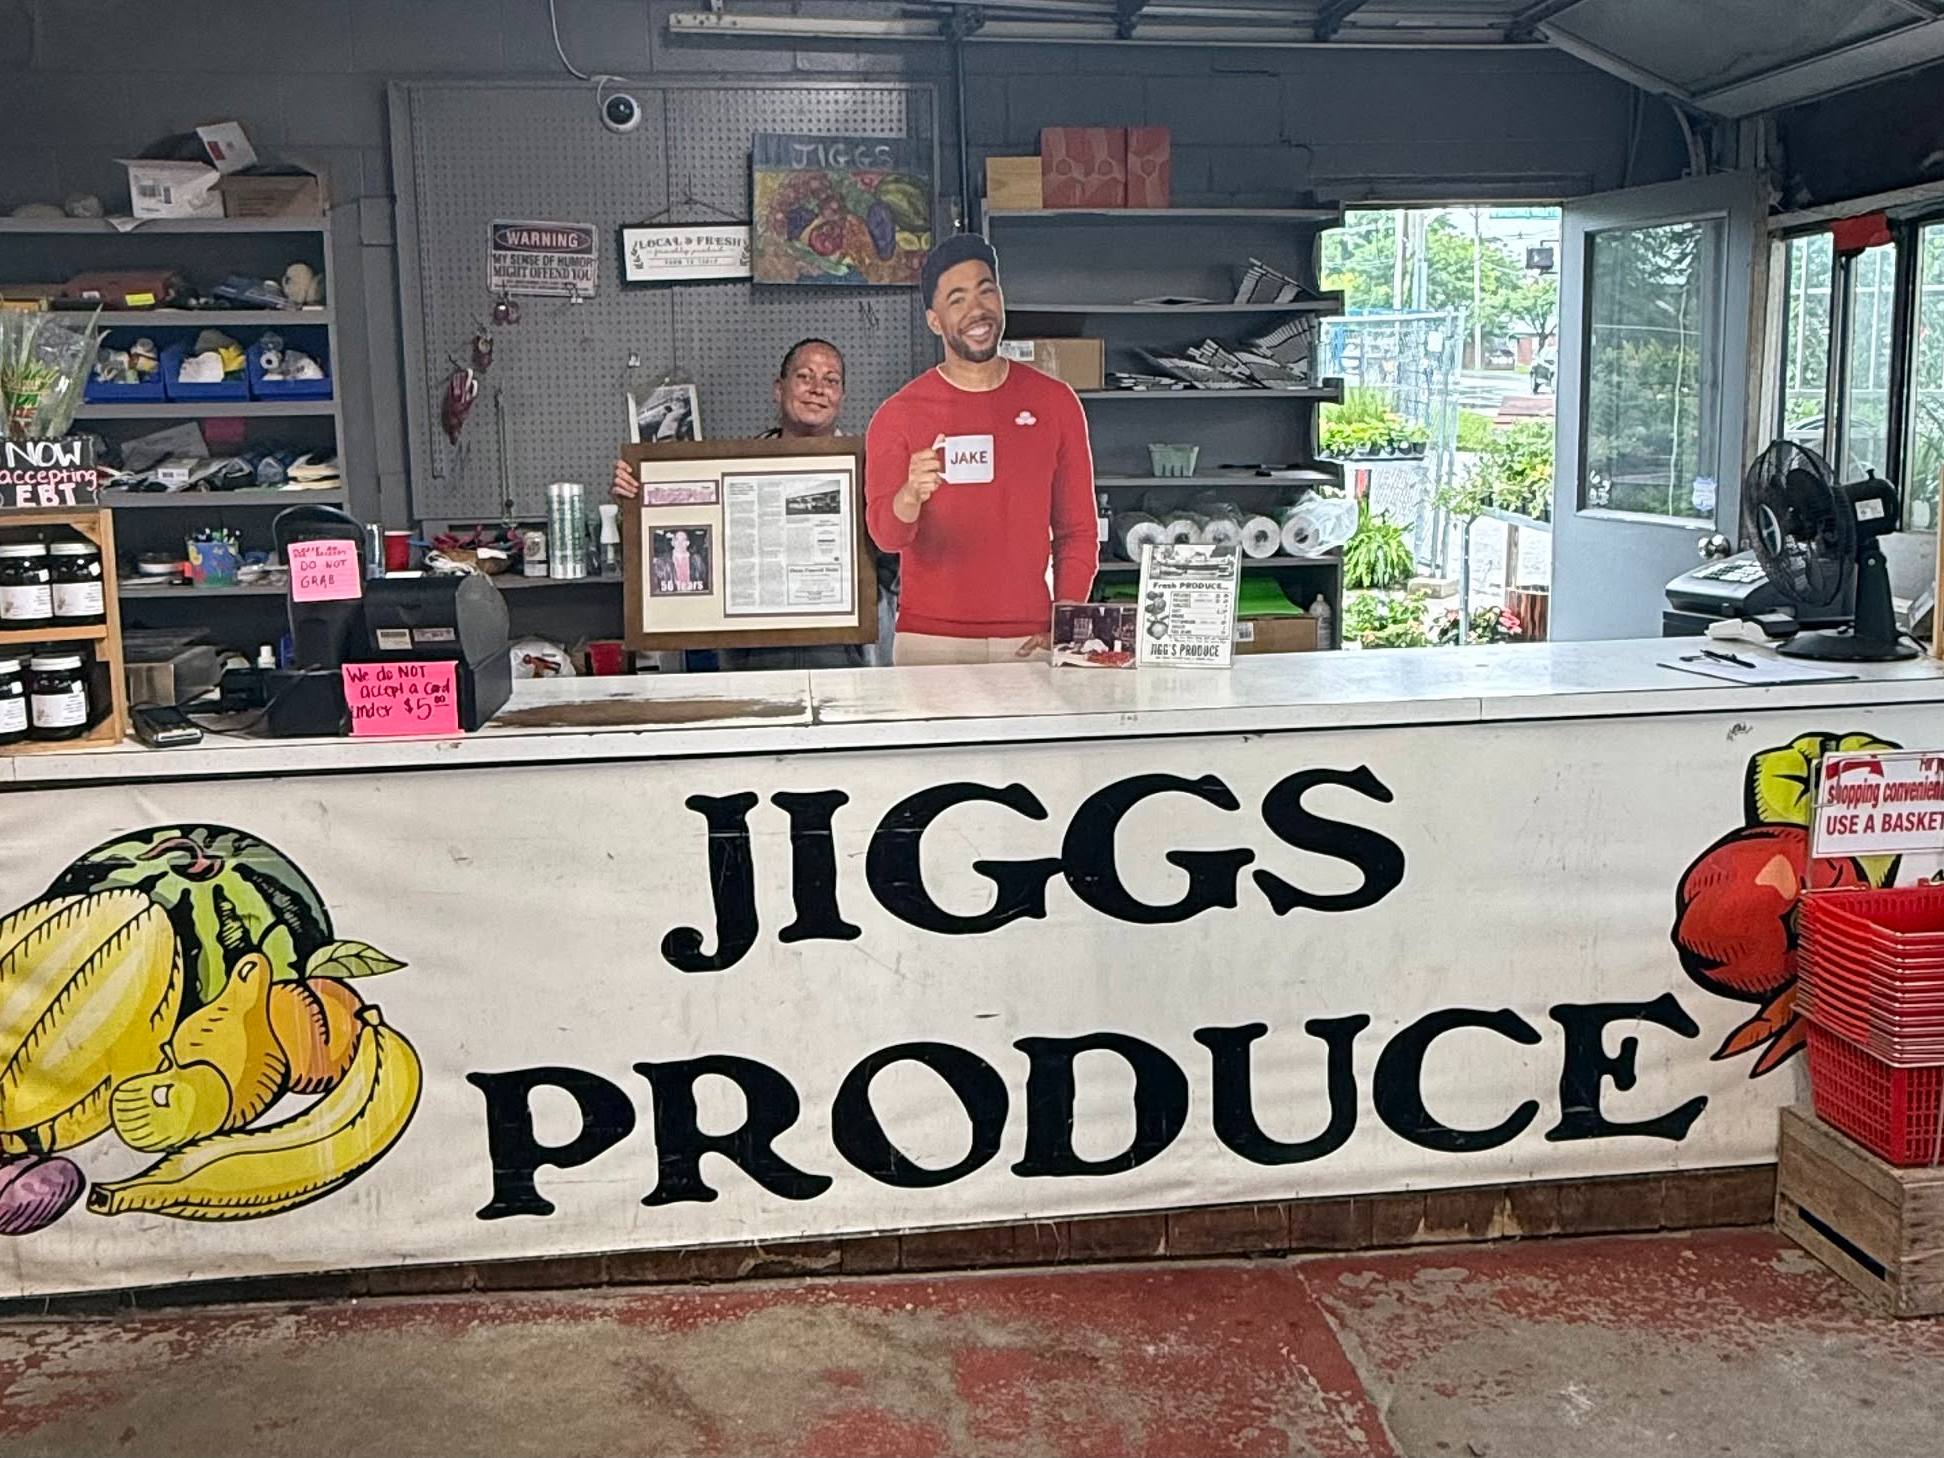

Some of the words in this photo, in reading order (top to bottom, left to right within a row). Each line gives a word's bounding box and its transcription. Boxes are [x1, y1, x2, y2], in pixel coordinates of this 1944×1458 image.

[791, 143, 893, 169] JIGGS
[505, 230, 579, 248] WARNING
[639, 236, 682, 249] LOCAL
[697, 236, 740, 247] FRESH
[493, 253, 508, 265] MY
[510, 254, 541, 266] SENSE
[542, 255, 556, 266] OF
[557, 256, 592, 268] HUMOR
[493, 265, 528, 278] MIGHT
[530, 266, 569, 279] OFFEND
[569, 268, 592, 281] YOU
[4, 440, 82, 468] NOW
[950, 450, 988, 465] JAKE
[0, 468, 98, 491] accepting
[16, 482, 76, 508] EBT
[300, 560, 317, 572] DO
[325, 559, 348, 569] NOT
[300, 574, 335, 589] GRAB
[1153, 581, 1177, 589] Fresh
[1179, 643, 1220, 658] PRODUCE
[346, 666, 369, 683] We
[376, 665, 394, 682] do
[398, 665, 427, 678] NOT
[360, 682, 404, 699] accept
[408, 682, 419, 695] a
[1827, 777, 1881, 810] shopping
[1825, 814, 1859, 836] USE
[1863, 813, 1876, 833] A
[1881, 811, 1944, 833] BASKET
[660, 764, 1406, 973] JIGGS
[466, 992, 1709, 1221] PRODUCE
